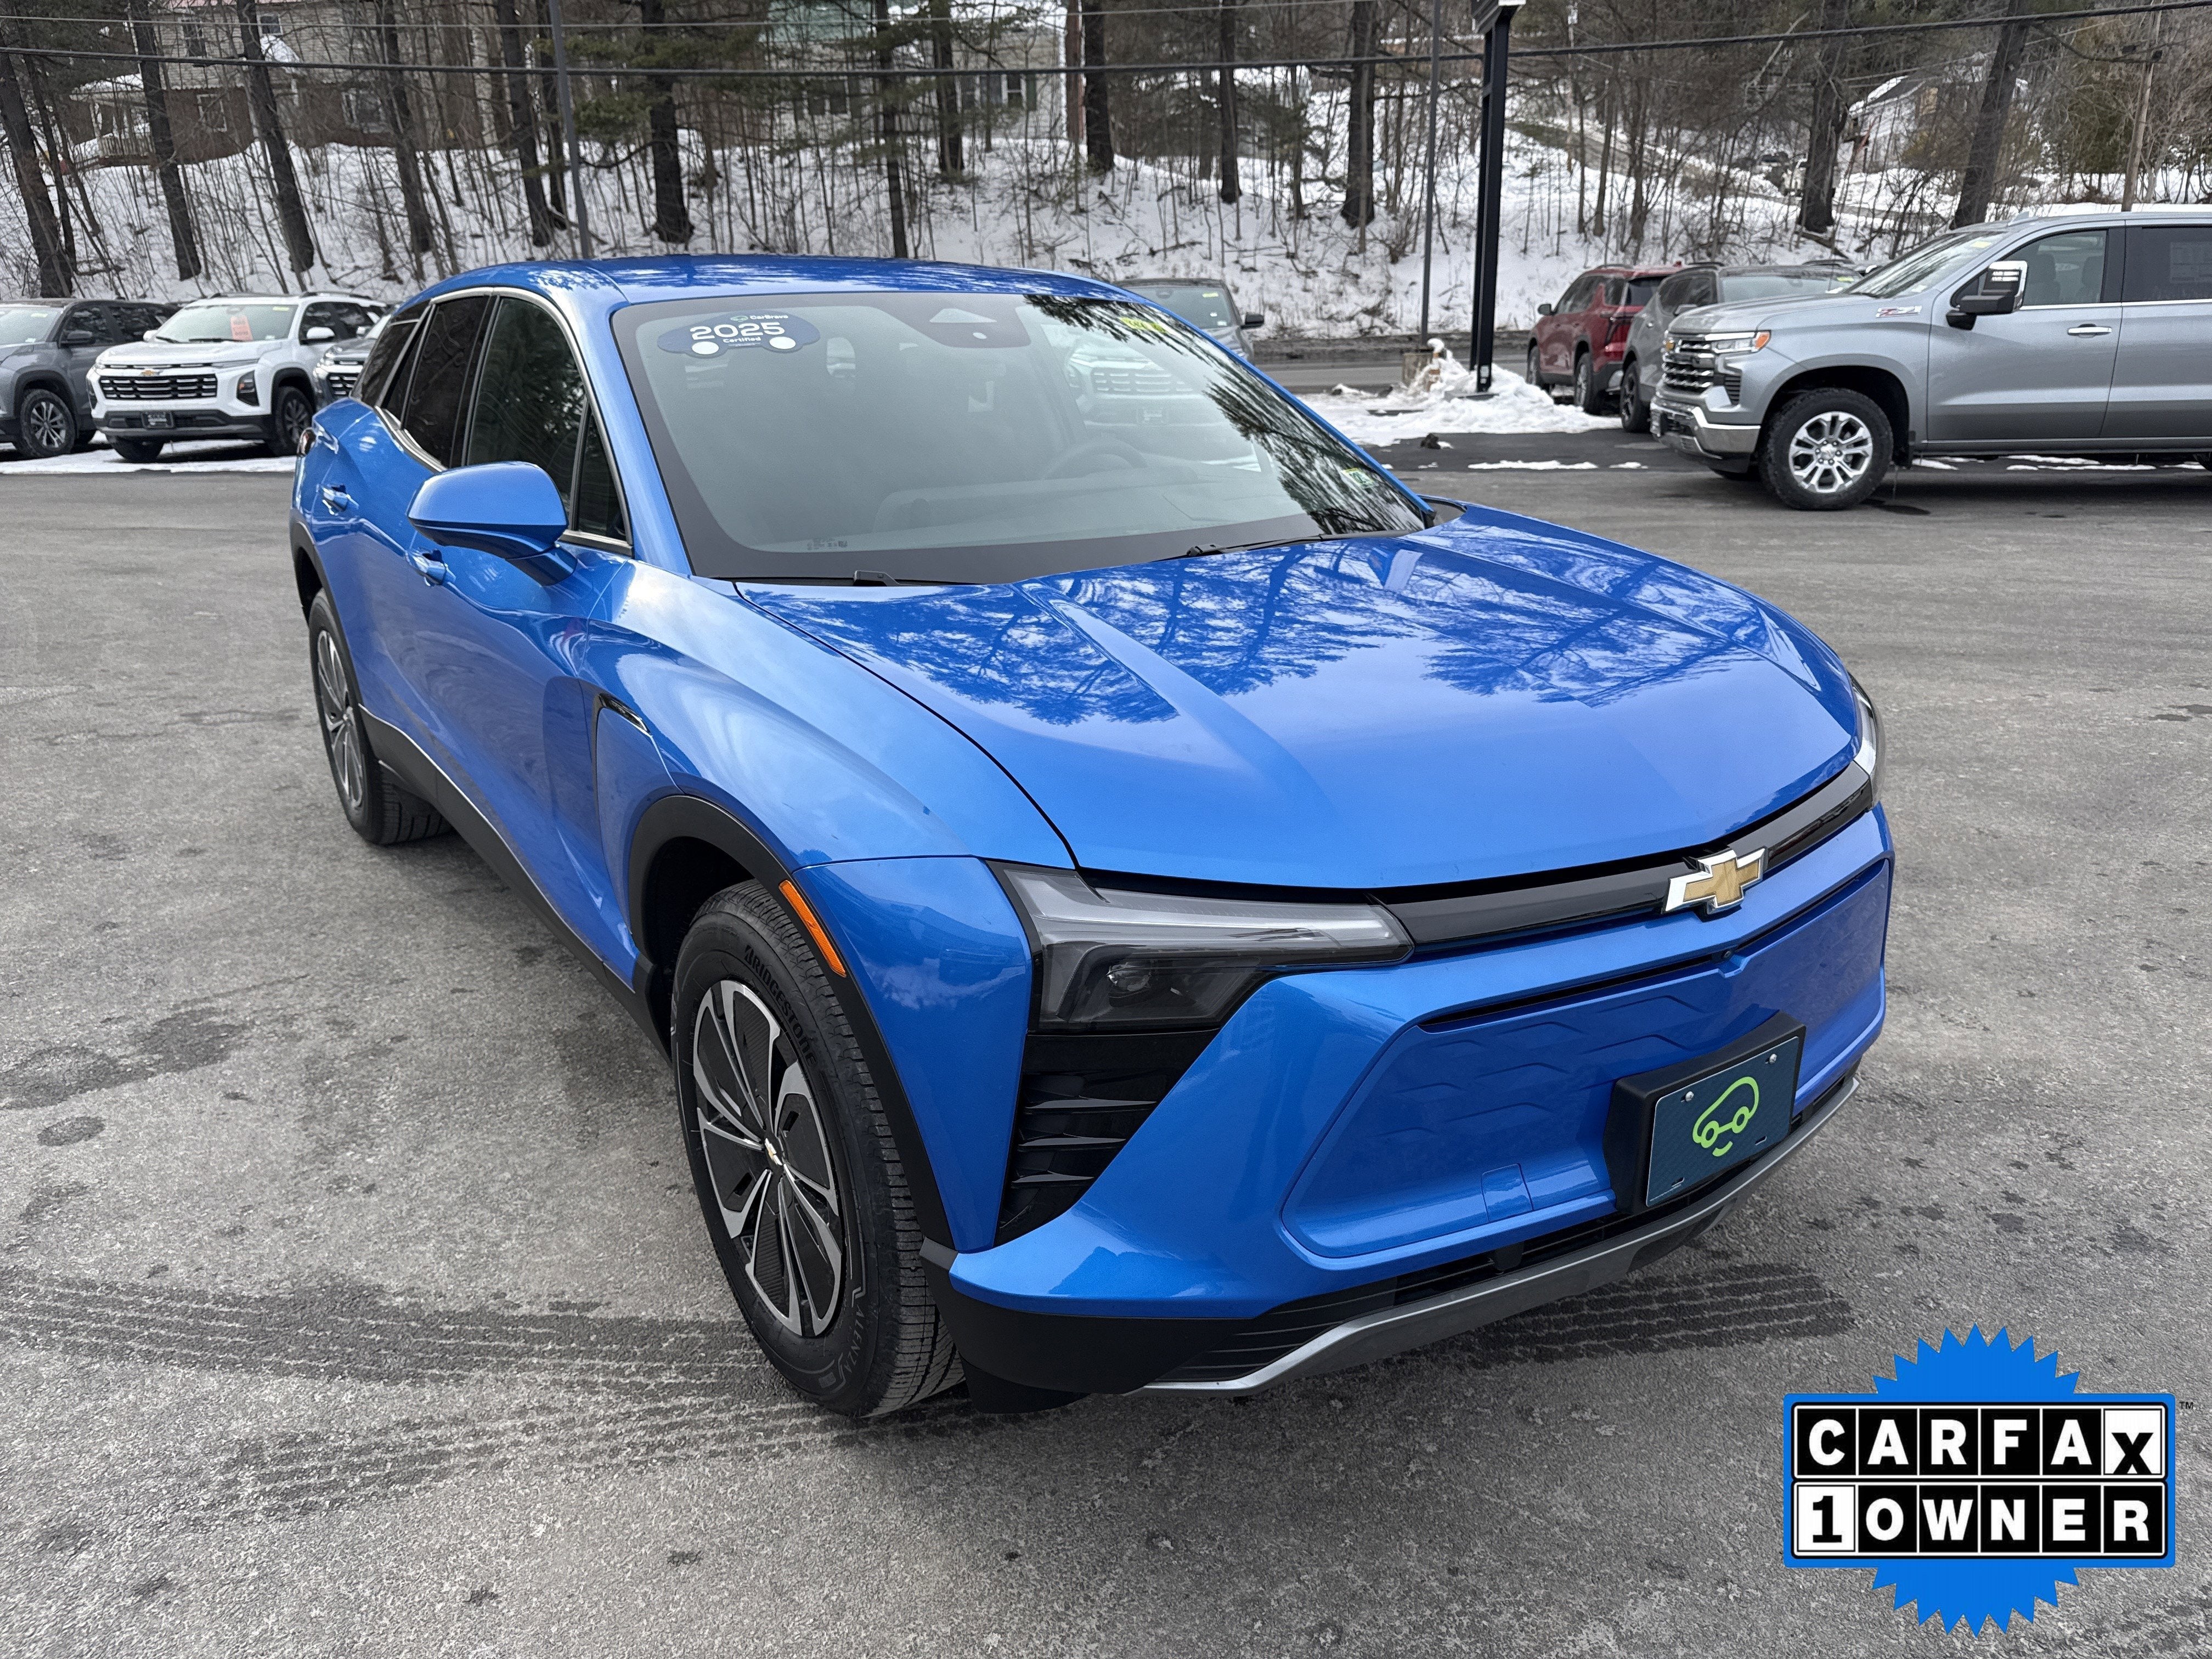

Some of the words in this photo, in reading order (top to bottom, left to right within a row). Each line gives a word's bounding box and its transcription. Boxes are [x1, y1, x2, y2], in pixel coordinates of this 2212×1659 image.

[690, 322, 785, 340] 2025
[744, 944, 817, 1067] BRIDGESTONE
[844, 1304, 865, 1372] ALENZA
